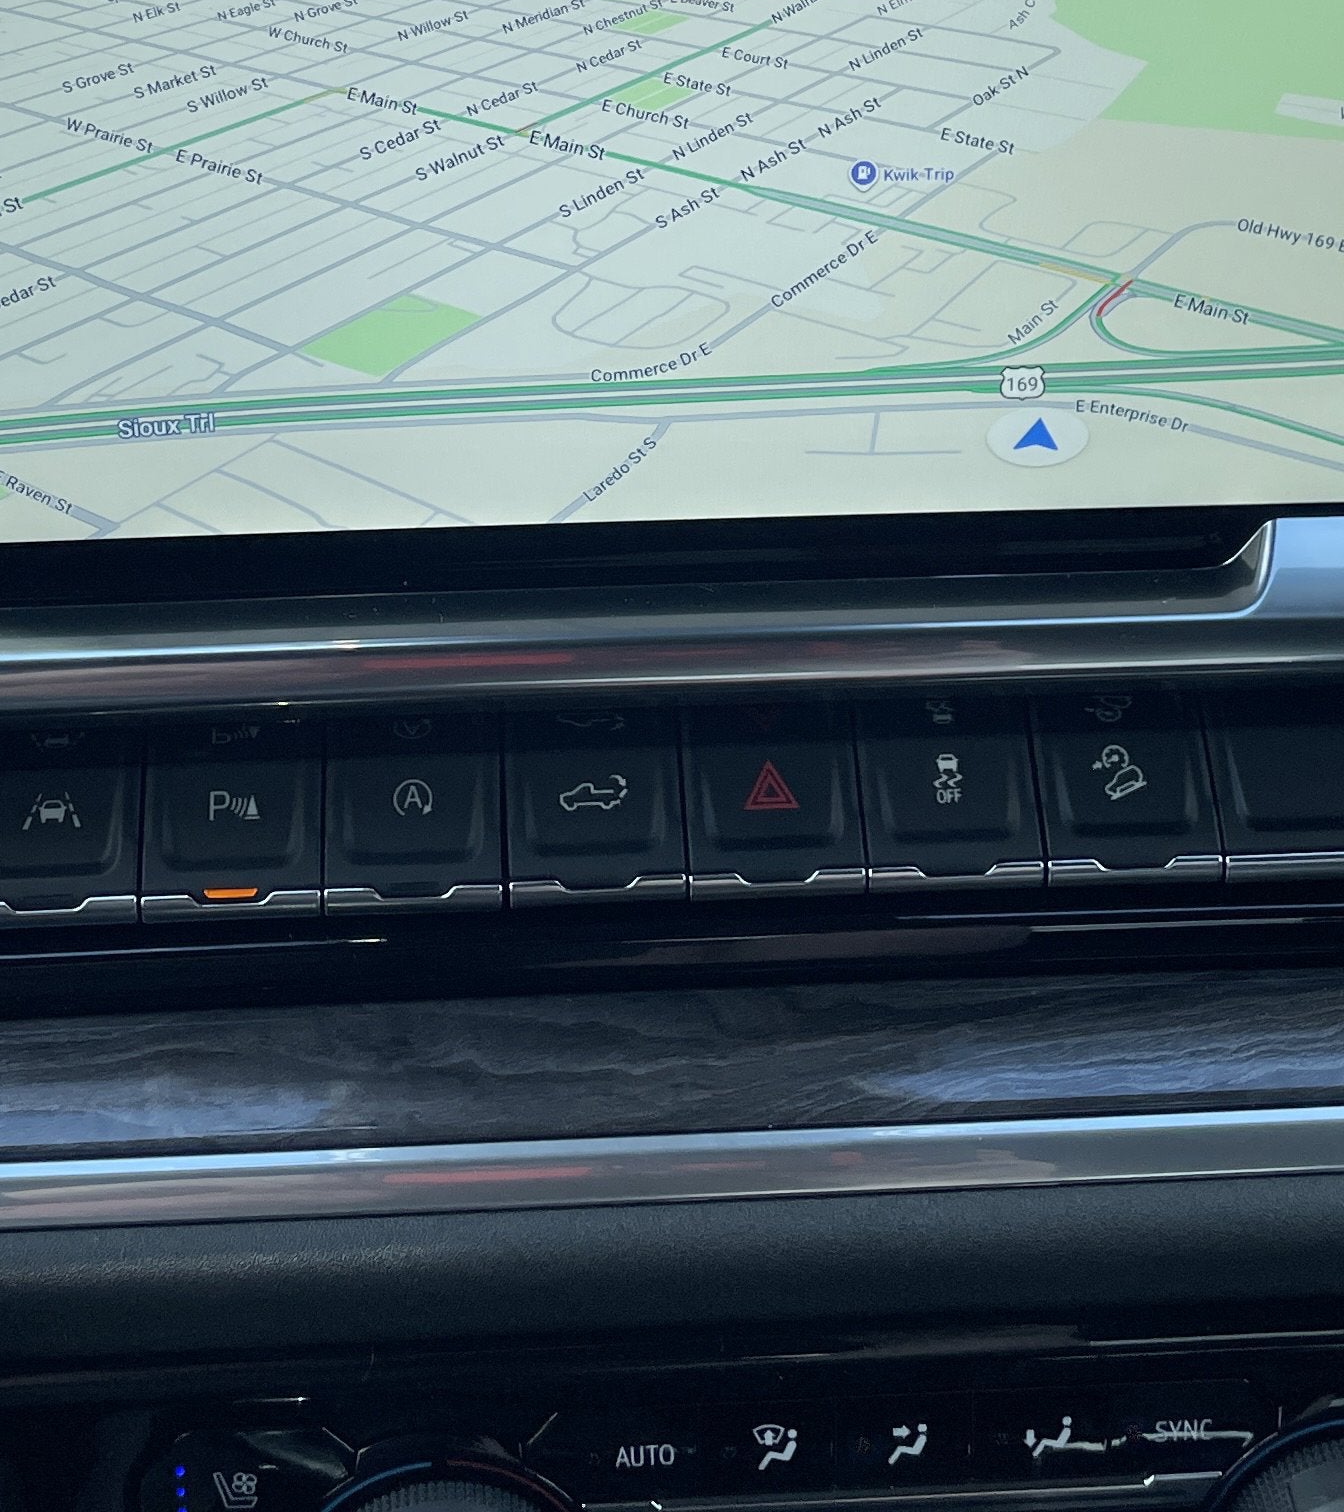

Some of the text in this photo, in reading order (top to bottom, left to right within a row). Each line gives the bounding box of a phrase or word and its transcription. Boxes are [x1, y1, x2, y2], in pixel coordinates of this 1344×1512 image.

[294, 11, 304, 22] N
[307, 2, 341, 17] Grove
[398, 11, 468, 41] N Willow St
[503, 0, 585, 34] N Meridian St
[583, 0, 662, 35] N Chestnut St
[771, 9, 784, 23] N
[1008, 8, 1028, 30] Ash
[269, 28, 347, 53] W Church St
[721, 47, 787, 69] E Court St
[63, 63, 133, 93] S Grove St
[134, 66, 216, 98] S Market St
[664, 72, 730, 96] E State St
[973, 66, 1028, 105] Oak St N
[187, 78, 267, 112] S Willow St
[348, 88, 419, 115] E Main St
[467, 82, 538, 116] N Cedar St
[602, 100, 688, 129] E Church St
[818, 98, 881, 137] N Ash St
[68, 118, 152, 153] W Prairie St
[360, 120, 440, 159] S Cedar St
[530, 131, 604, 160] E Main St
[673, 113, 752, 160] N Linden St
[941, 128, 1014, 154] E State St
[175, 146, 262, 184] E Prairie St
[416, 136, 504, 180] S Walnut St
[741, 140, 806, 181] N Ash St
[884, 168, 954, 183] Kwik Trip
[4, 197, 23, 212] St
[560, 169, 643, 217] S Linden St
[656, 188, 719, 228] S Ash St
[1238, 218, 1264, 234] Old
[1268, 226, 1302, 246] Hwy
[1307, 232, 1335, 248] 169
[771, 231, 877, 306] Commerce Dr E
[37, 277, 55, 291] St
[1008, 301, 1058, 346] Main St
[1175, 294, 1251, 324] E Main St
[591, 342, 712, 382] Commerce Dr E
[1008, 377, 1038, 391] 169
[118, 413, 215, 439] Sioux Trl
[1076, 400, 1187, 432] E Enterprise Dr
[584, 438, 656, 500] Laredo St S
[6, 476, 52, 504] Raven
[55, 499, 72, 514] St
[937, 788, 962, 803] OFF
[1156, 1419, 1212, 1442] SYNC
[616, 1444, 674, 1468] AUTO
